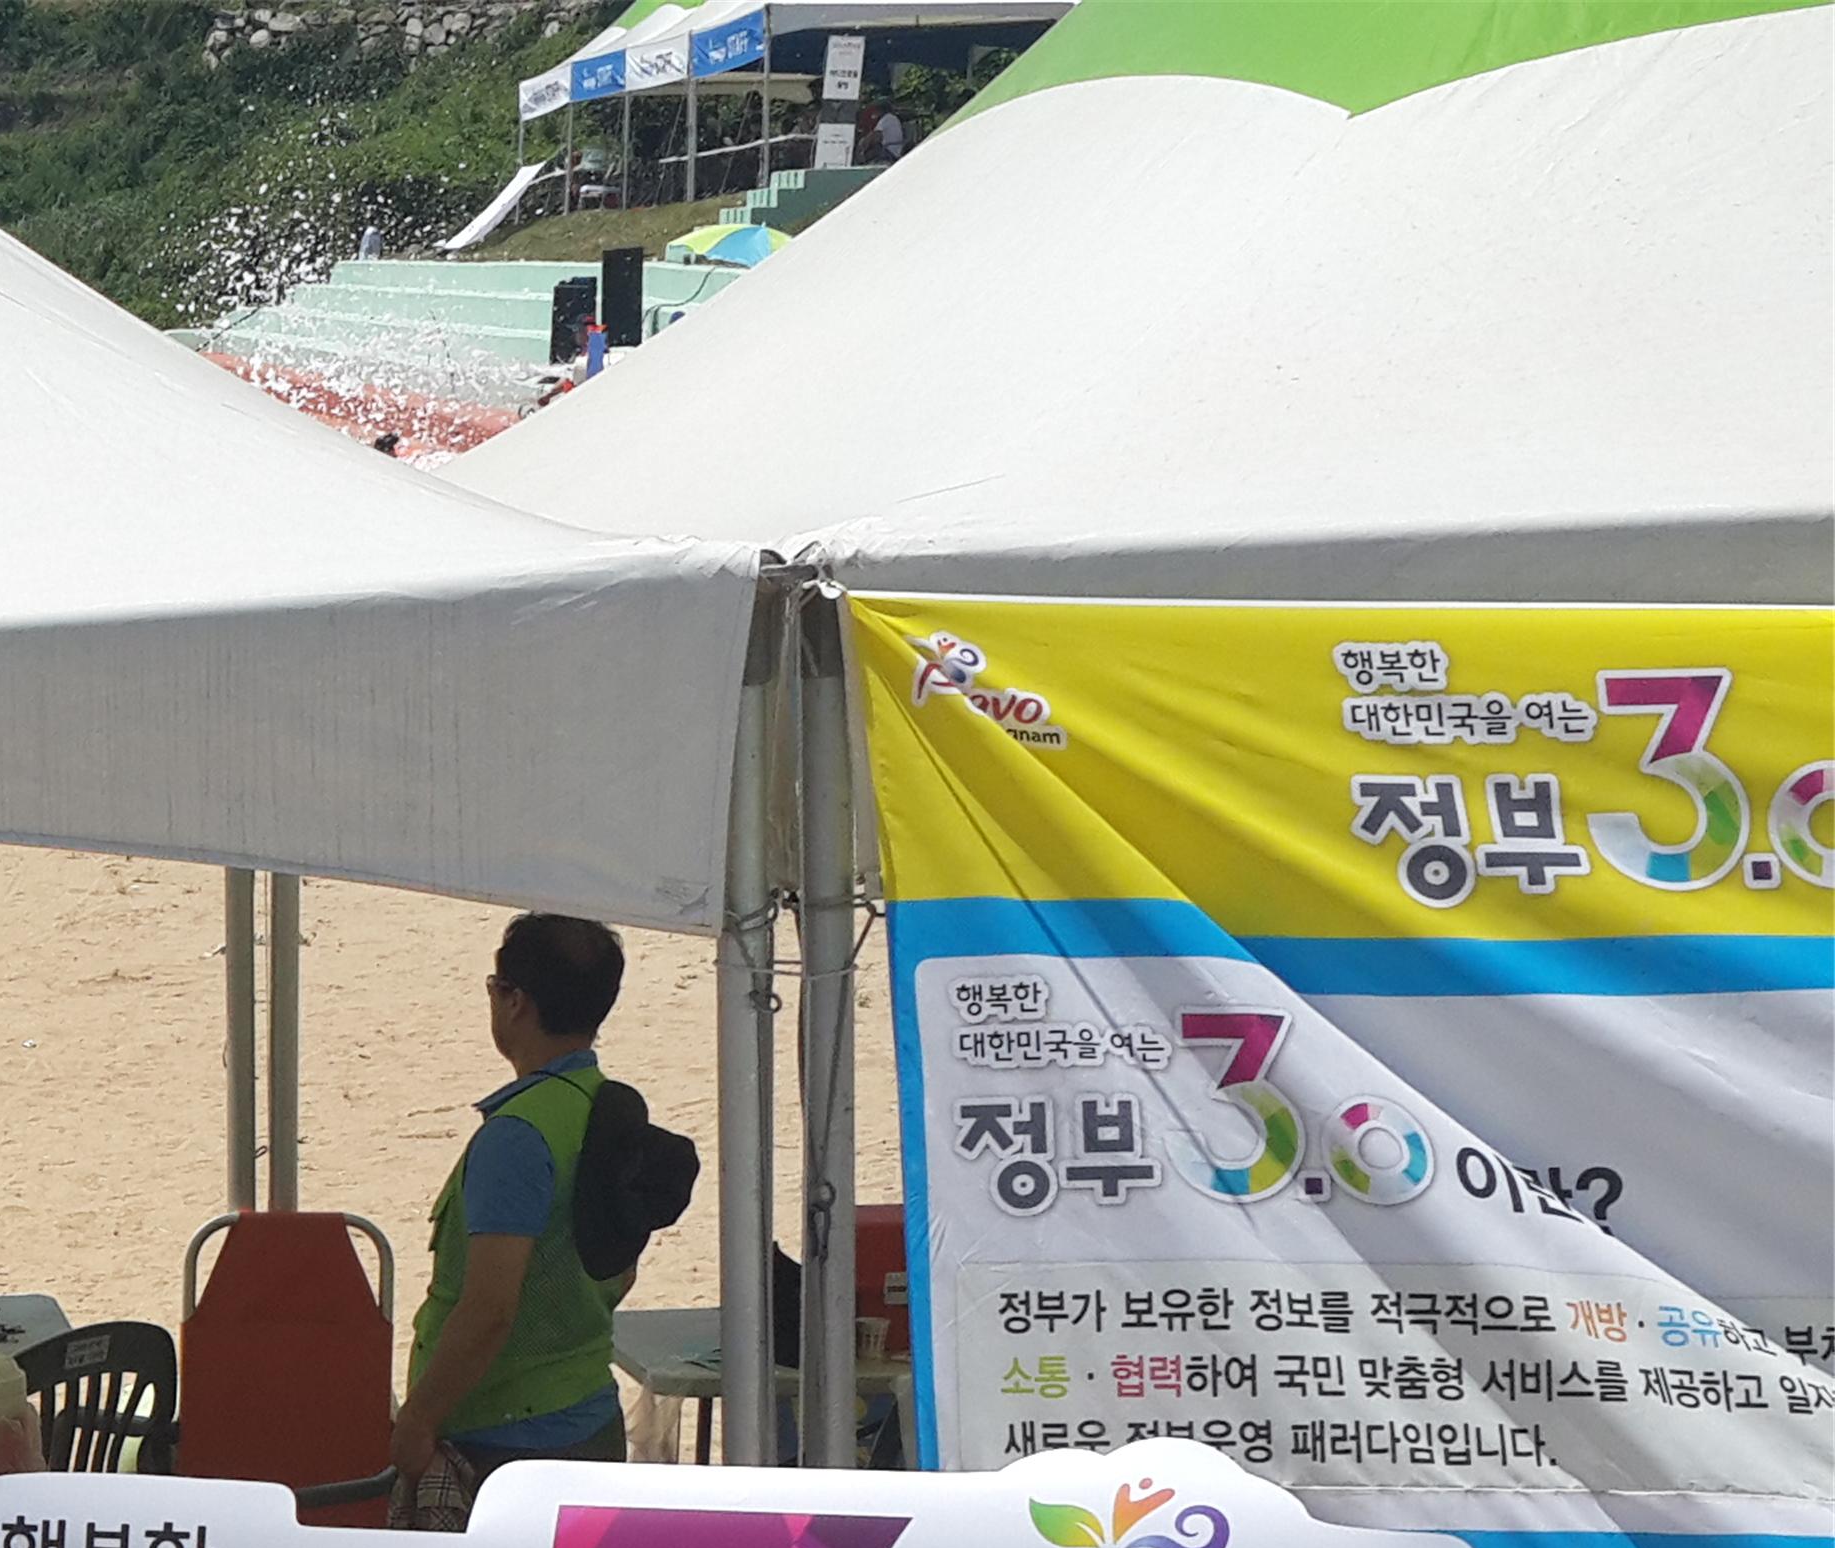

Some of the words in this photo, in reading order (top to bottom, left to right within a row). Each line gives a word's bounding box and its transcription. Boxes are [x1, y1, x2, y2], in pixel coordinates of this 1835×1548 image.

[1342, 648, 1440, 687] 행복한
[1351, 697, 1512, 739] 대한민국을
[1525, 702, 1593, 736] 여는
[1357, 781, 1581, 895] 정부
[955, 982, 1042, 1017] 행복한
[958, 1028, 1100, 1067] 대한민국을
[1109, 1031, 1169, 1066] 여는
[998, 1291, 1107, 1336] 정부가
[1121, 1289, 1234, 1335] 보유한
[1248, 1288, 1354, 1335] 정보를
[1369, 1293, 1557, 1340] 적극적으로
[1567, 1297, 1628, 1342] 개방
[1001, 1356, 1071, 1400] 소통
[1111, 1352, 1259, 1400] 협력하여
[1273, 1354, 1345, 1400] 국민
[1358, 1354, 1466, 1402] 맞춤형
[1481, 1353, 1628, 1404] 서비스를
[1638, 1367, 1769, 1413] 제공하고
[1291, 1420, 1558, 1467] 패러다임입니다.
